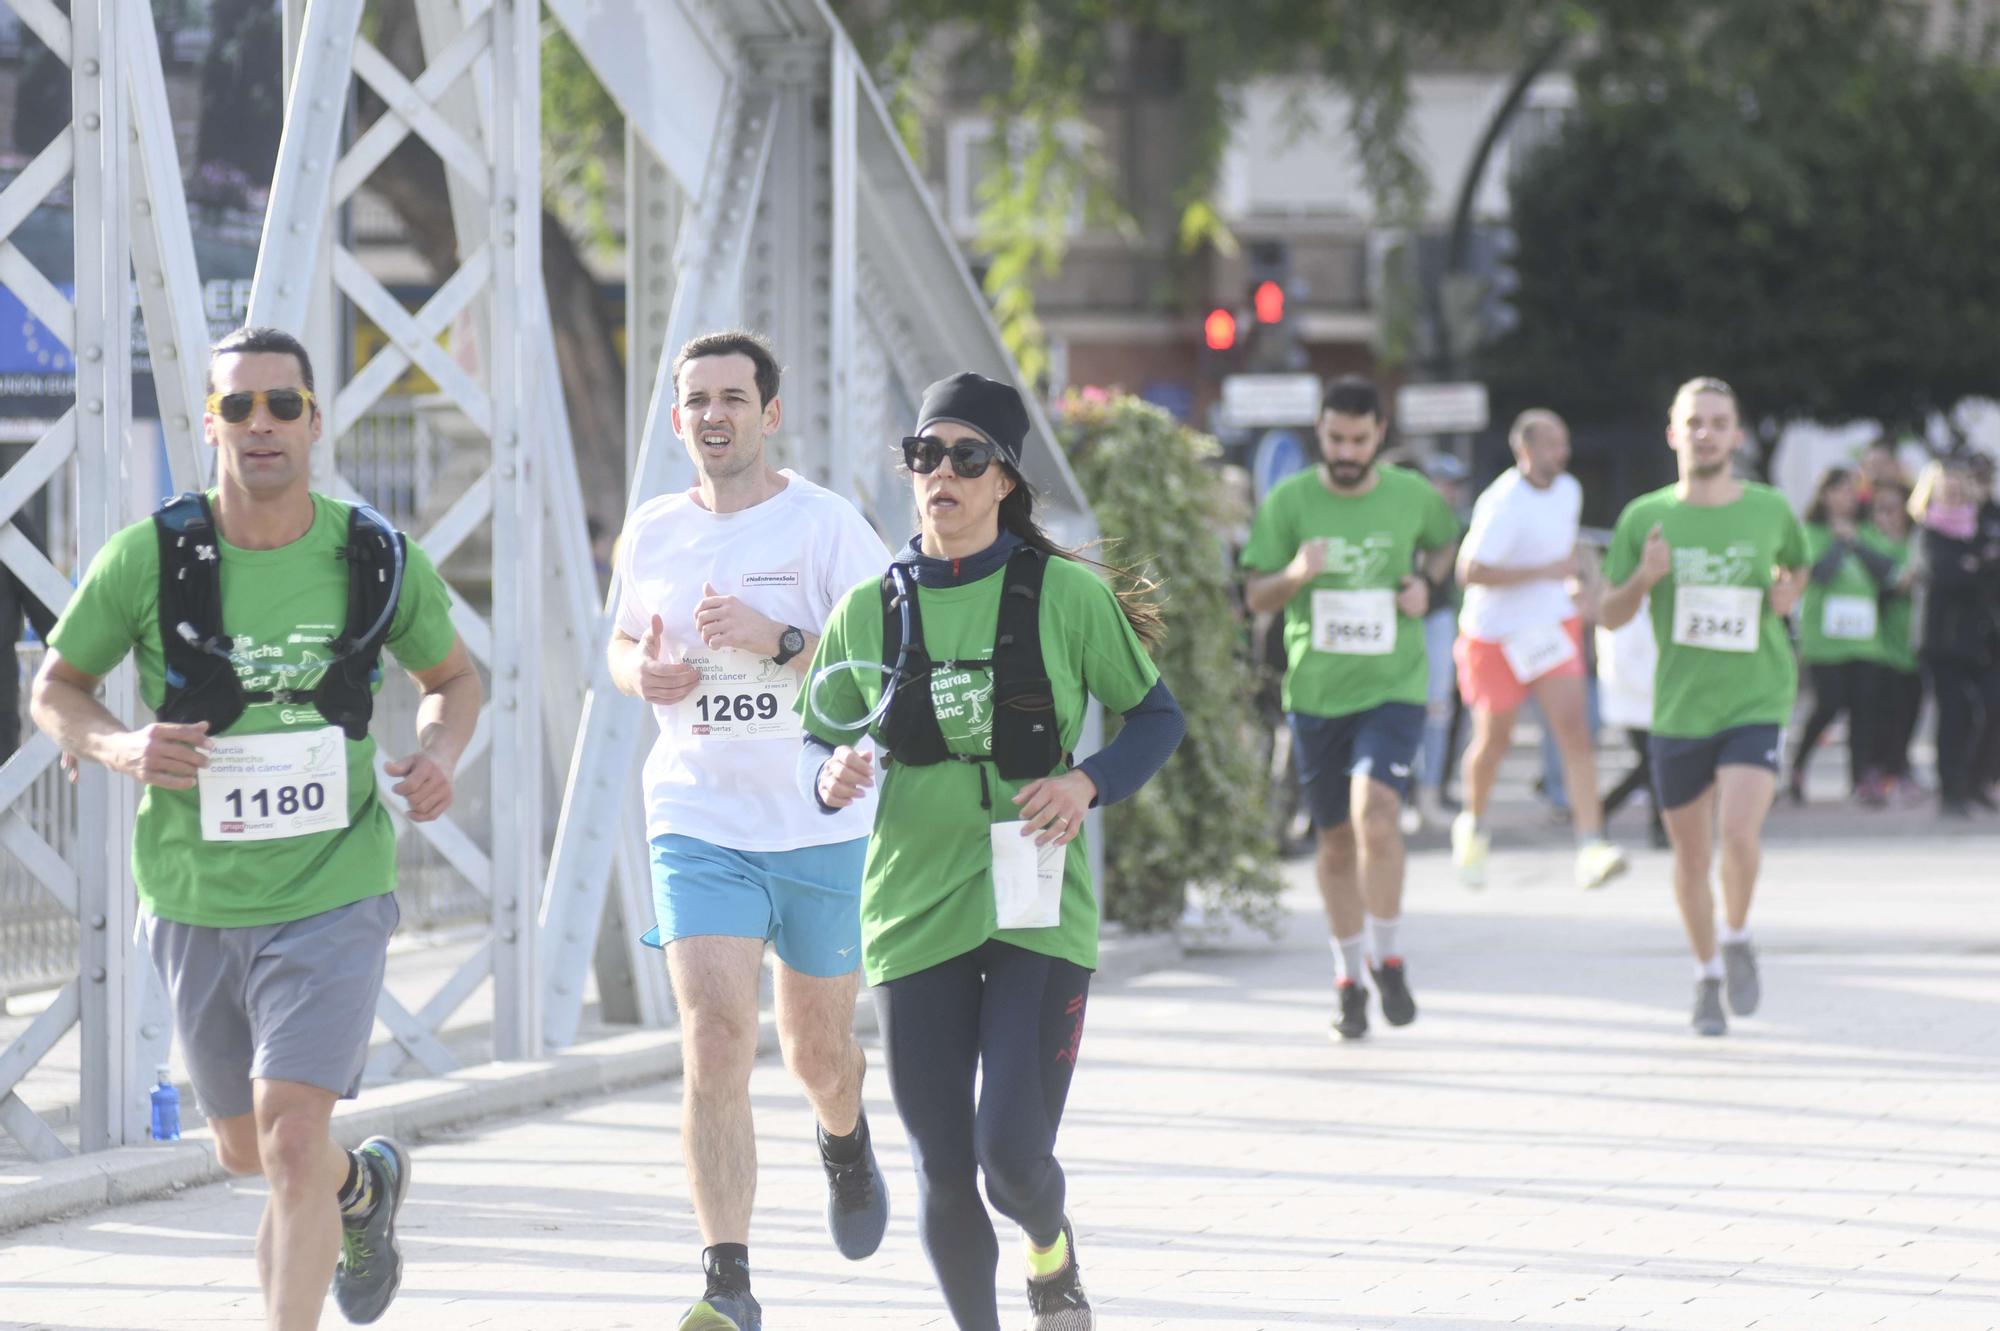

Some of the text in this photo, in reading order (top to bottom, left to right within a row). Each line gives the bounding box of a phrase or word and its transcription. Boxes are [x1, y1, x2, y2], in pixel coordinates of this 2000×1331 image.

[696, 692, 778, 722] 1269
[210, 765, 244, 774] contra
[224, 782, 325, 818] 1180
